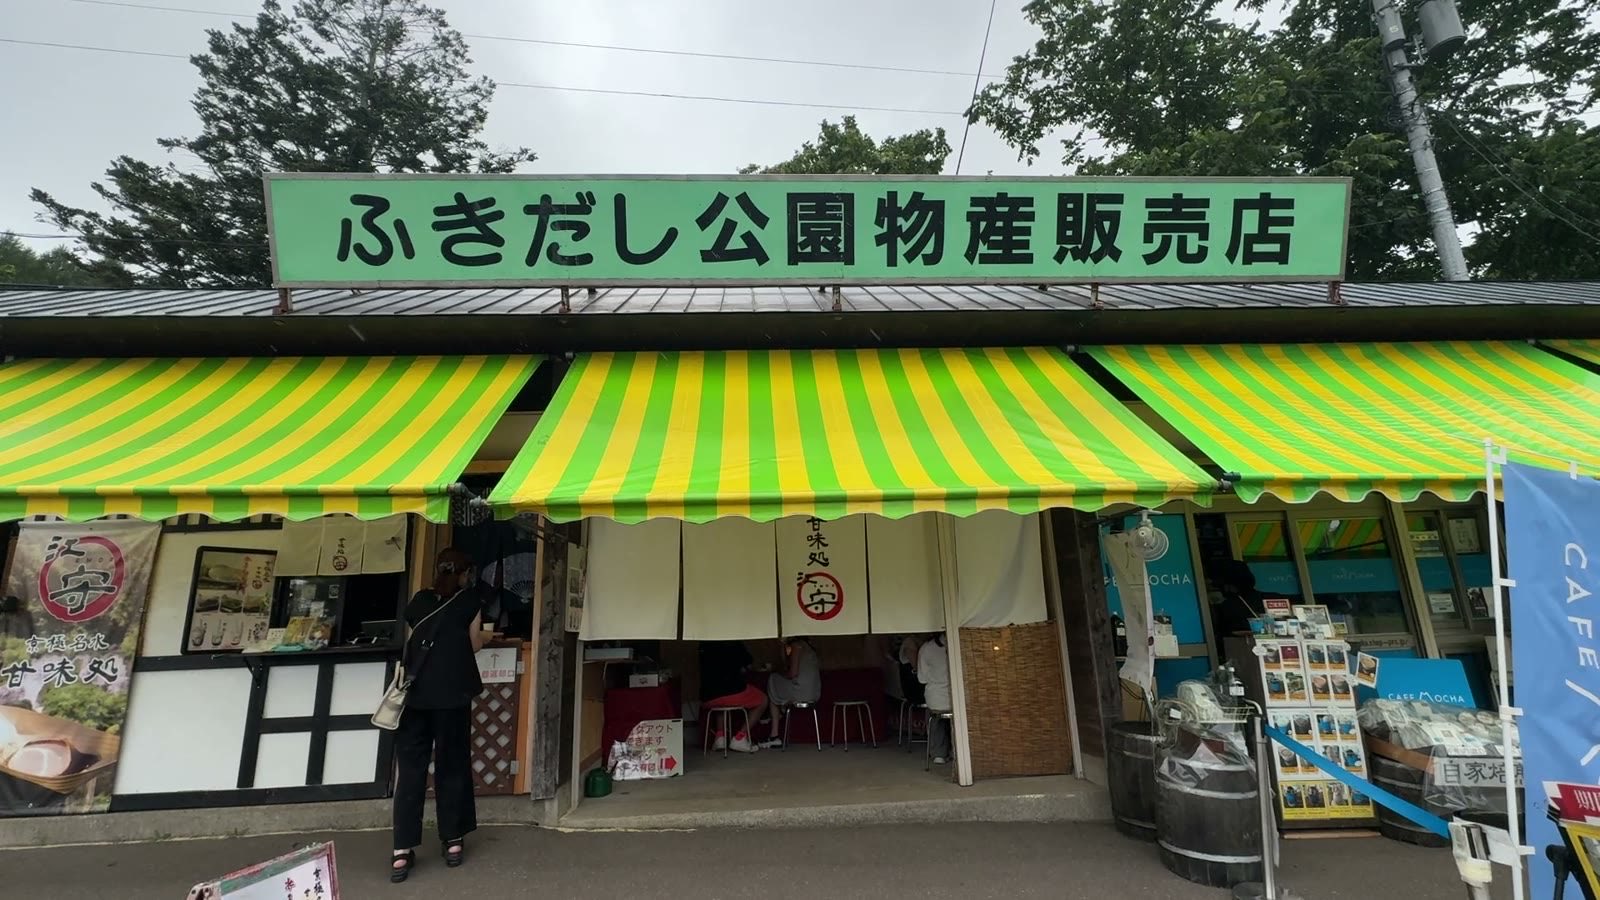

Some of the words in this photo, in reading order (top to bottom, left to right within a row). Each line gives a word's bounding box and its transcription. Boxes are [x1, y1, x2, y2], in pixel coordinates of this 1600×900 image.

[337, 191, 1294, 267] ふきだし公園物産販売店
[806, 516, 829, 567] 甘味処
[1149, 573, 1192, 586] OCHA
[25, 632, 110, 653] 京極名水
[1, 657, 120, 689] 甘味処
[1419, 691, 1465, 703] MOCHA
